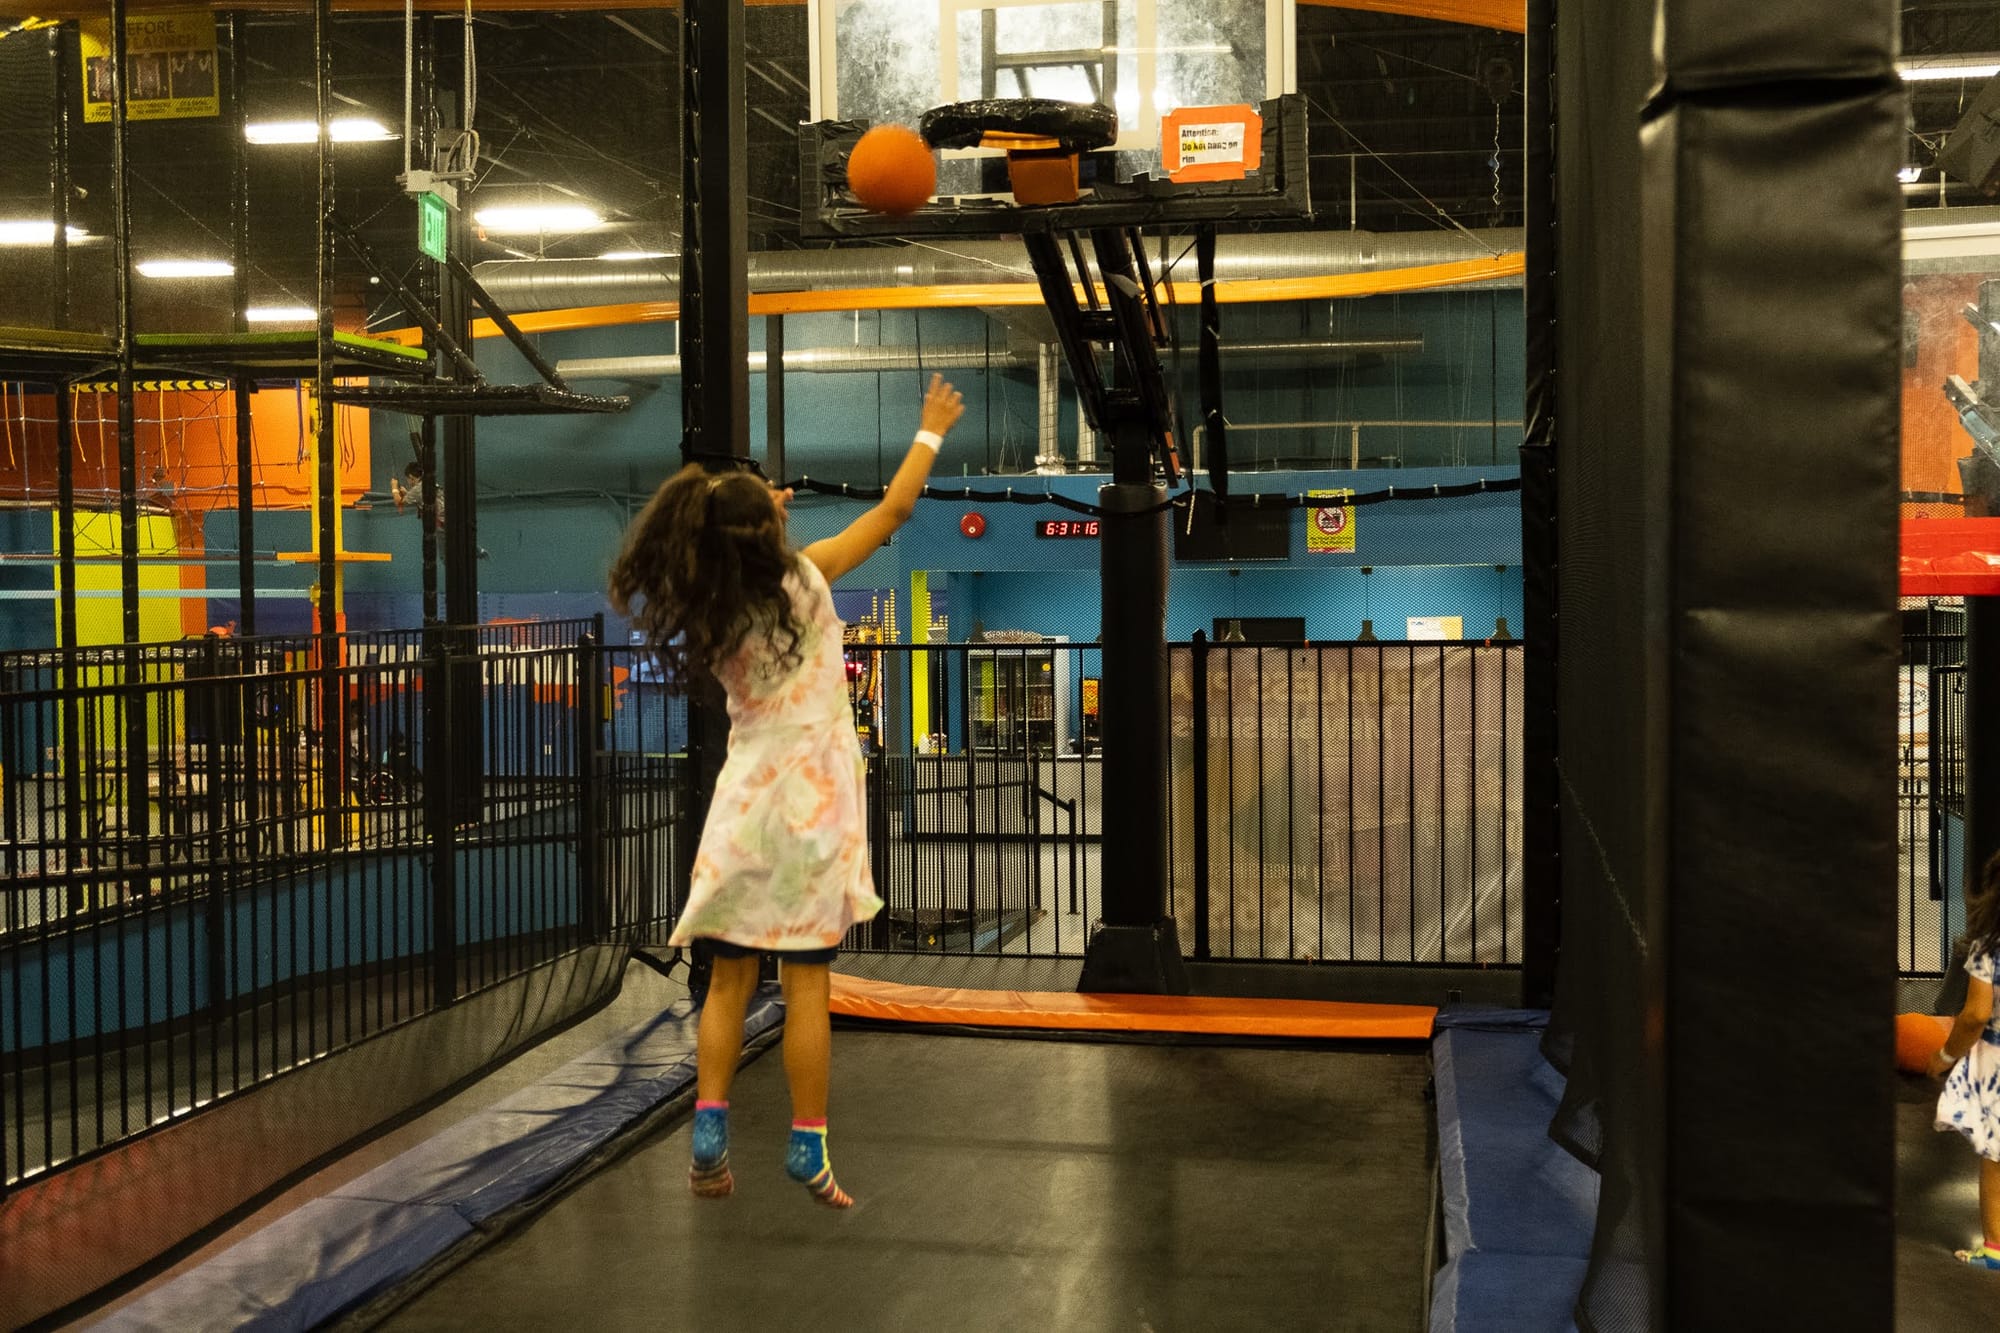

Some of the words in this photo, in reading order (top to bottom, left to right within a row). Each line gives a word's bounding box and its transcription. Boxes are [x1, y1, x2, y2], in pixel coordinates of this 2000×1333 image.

[127, 20, 176, 36] EFORE
[1182, 143, 1192, 151] Do
[1046, 522, 1098, 535] 6:31:16
